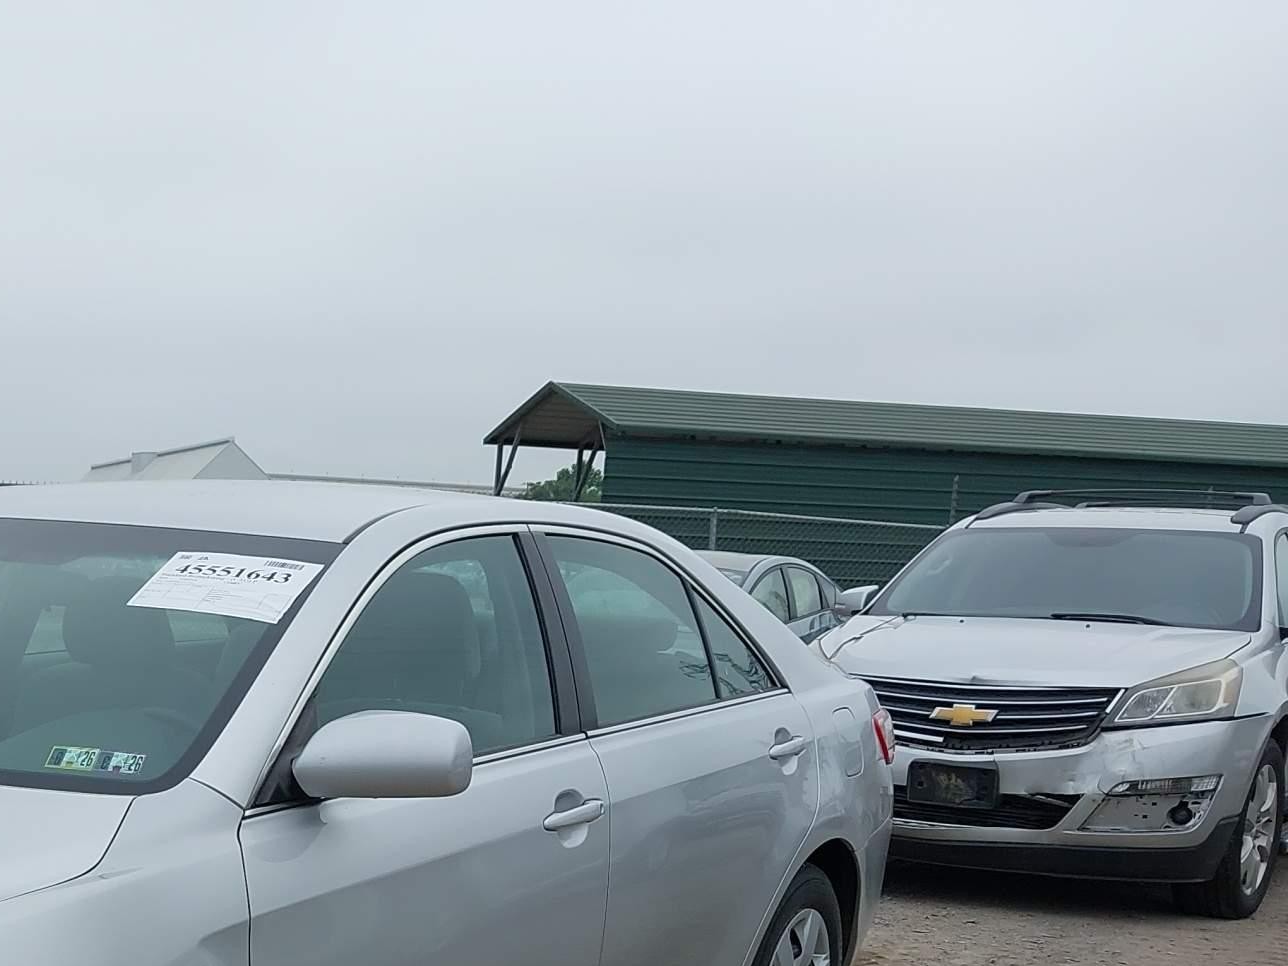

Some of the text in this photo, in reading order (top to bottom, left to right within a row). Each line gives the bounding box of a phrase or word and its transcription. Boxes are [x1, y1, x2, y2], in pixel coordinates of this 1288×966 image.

[175, 564, 293, 584] 45551643
[79, 750, 97, 767] 26
[128, 755, 143, 772] 26
